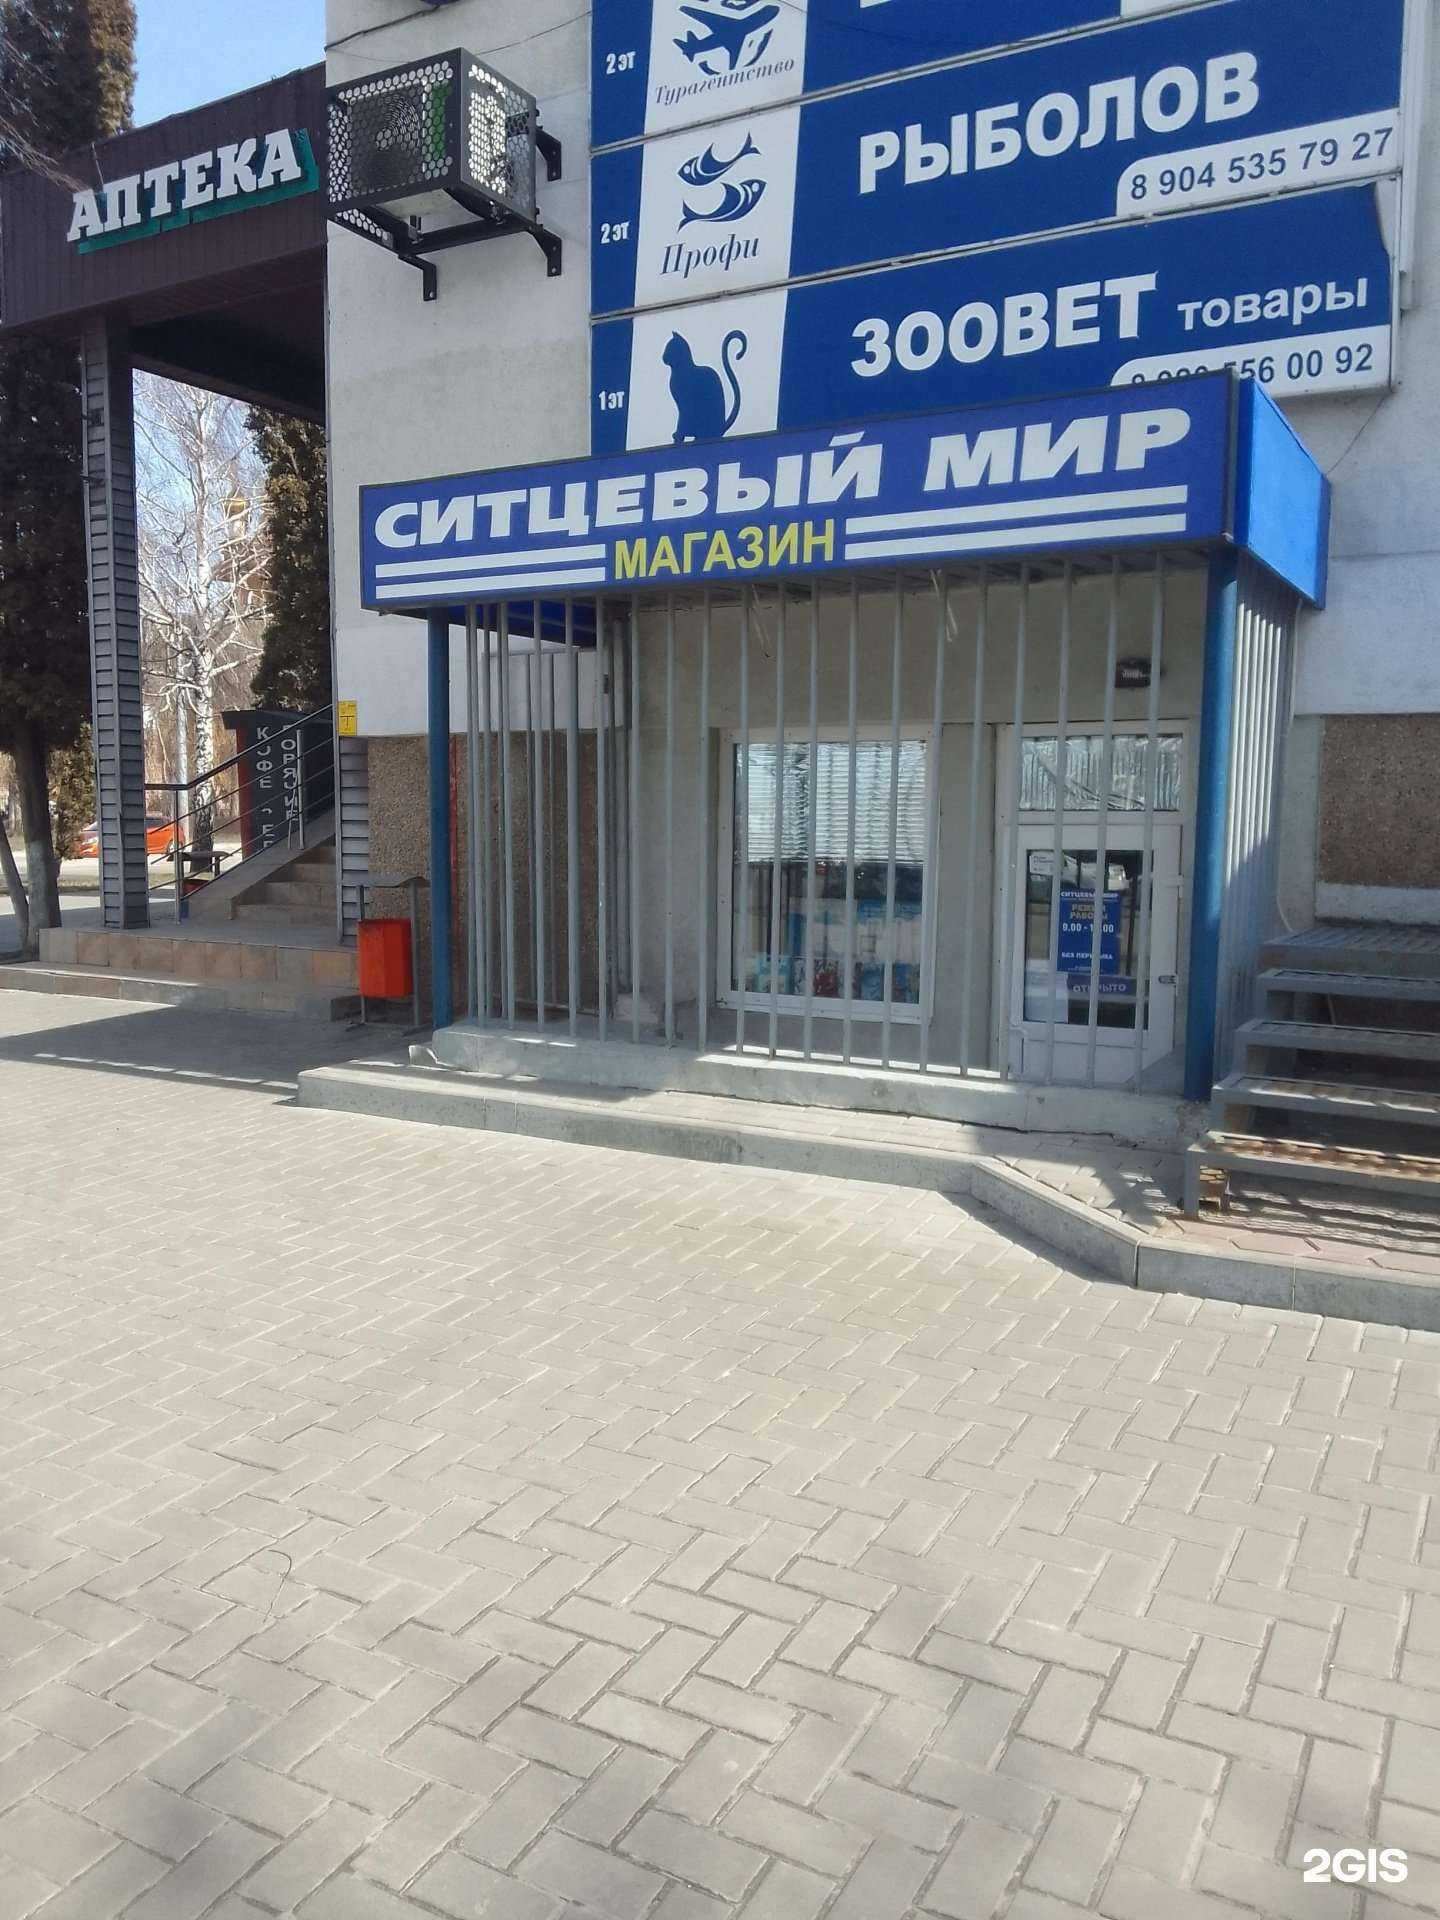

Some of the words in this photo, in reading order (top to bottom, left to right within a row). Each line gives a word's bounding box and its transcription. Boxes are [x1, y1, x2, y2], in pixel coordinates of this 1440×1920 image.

[655, 58, 795, 106] Турагентство
[859, 51, 1260, 195] РЫБОЛОВ
[67, 128, 301, 242] АПТЕКА
[1131, 174, 1147, 200] 8
[1159, 162, 1215, 195] 904
[1228, 148, 1286, 183] 535
[1300, 138, 1338, 170] 79
[1352, 127, 1393, 161] 27
[659, 233, 759, 279] Профи
[851, 270, 1158, 377] ЗООВЕТ
[1177, 277, 1368, 325] товары
[1224, 356, 1274, 383] 56
[1287, 350, 1322, 380] 00
[1336, 343, 1373, 374] 92
[374, 431, 883, 548] СИТЦЕВЫЙ
[923, 408, 1191, 492] МИР
[614, 518, 835, 581] МАГАЗИН
